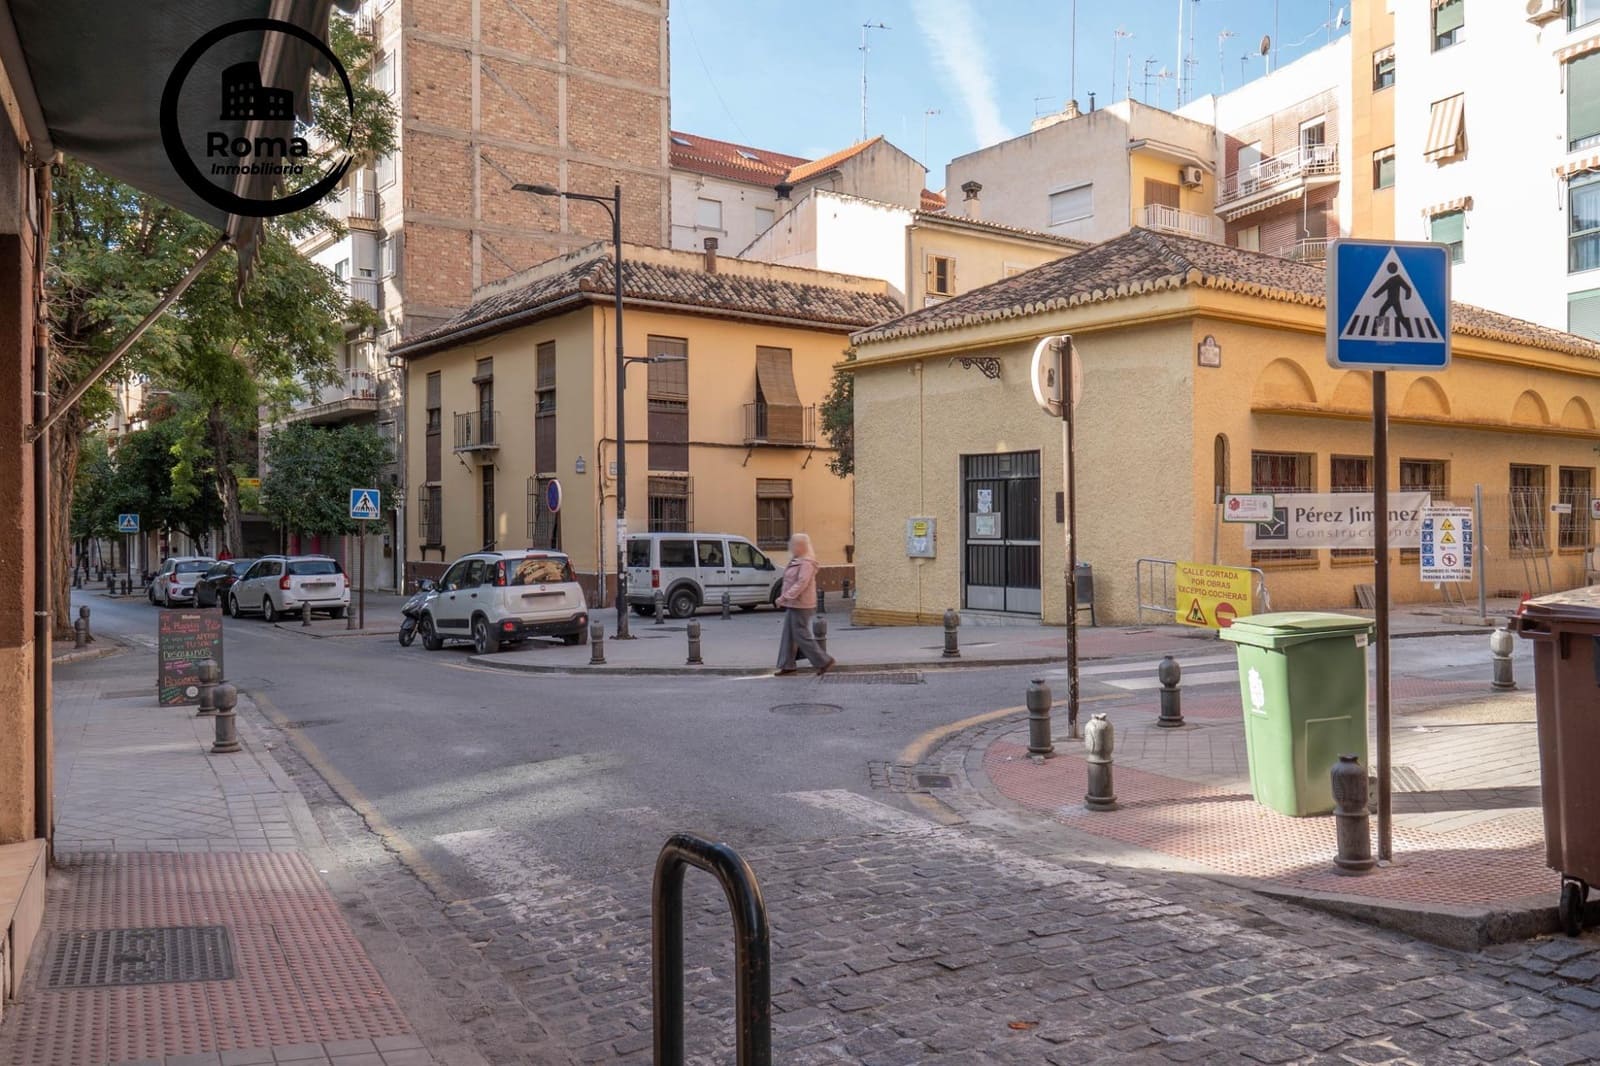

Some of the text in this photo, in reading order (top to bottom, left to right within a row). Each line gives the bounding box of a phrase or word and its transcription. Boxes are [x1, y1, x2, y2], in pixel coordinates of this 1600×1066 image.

[1295, 506, 1419, 525] Pérez Jimnez
[1295, 527, 1420, 539] Construccnes
[1183, 568, 1239, 580] CALLE CORTADA
[1191, 578, 1231, 589] POR OBRAS
[1178, 585, 1248, 601] EXCEPTO COCHERAS
